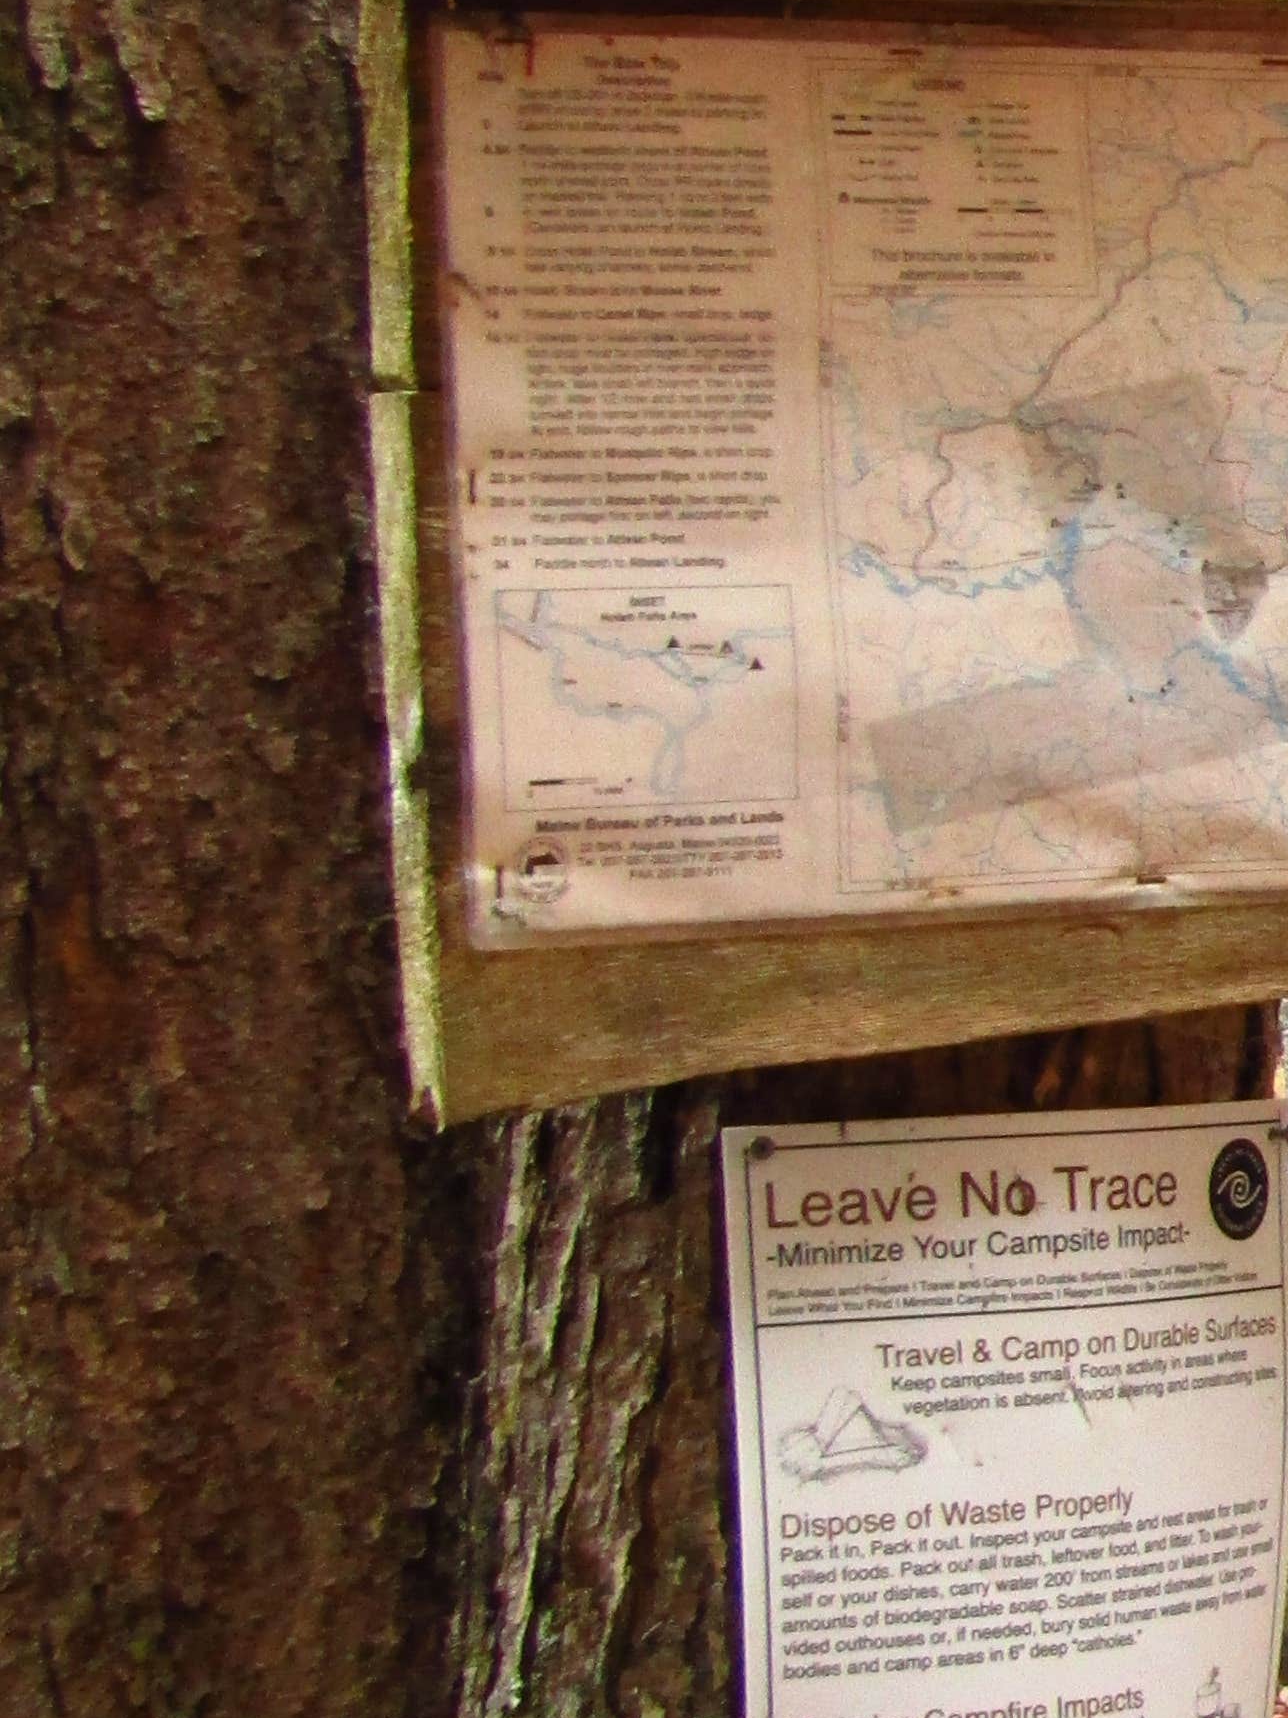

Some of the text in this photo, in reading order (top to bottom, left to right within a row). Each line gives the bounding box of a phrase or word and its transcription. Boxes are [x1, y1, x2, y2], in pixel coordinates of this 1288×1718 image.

[765, 1181, 936, 1228] Leave
[960, 1170, 1035, 1217] No
[1052, 1165, 1177, 1212] Trace
[914, 1235, 977, 1260] Your
[987, 1227, 1109, 1259] Campsite
[874, 1316, 1275, 1368] Travel & Camp on Durable Surfaces
[891, 1376, 935, 1393] Keep
[940, 1370, 1024, 1390] campsites
[1079, 1364, 1121, 1379] Focus
[903, 1395, 989, 1416] vegetation
[995, 1393, 1007, 1408] is
[1167, 1376, 1187, 1393] and
[781, 1485, 1133, 1541] Dispose of Waste Properly
[780, 1544, 823, 1562] Pack
[870, 1538, 912, 1555] Pack
[969, 1530, 1028, 1550] Inspect
[1033, 1528, 1065, 1546] your
[1136, 1514, 1159, 1531] and
[781, 1567, 835, 1589] spilled
[900, 1559, 941, 1577] Pack
[947, 1558, 972, 1573] out
[978, 1554, 996, 1571] all
[1051, 1546, 1104, 1564] leftover
[1144, 1535, 1167, 1552] and
[782, 1592, 812, 1610] self
[817, 1594, 834, 1607] or
[840, 1591, 877, 1609] your
[949, 1582, 990, 1597] carry
[995, 1576, 1038, 1592] water
[1080, 1568, 1110, 1584] from
[782, 1615, 857, 1633] amounts
[862, 1611, 879, 1627] of
[884, 1601, 1003, 1625] biodegradable
[1056, 1591, 1107, 1609] Scatter
[783, 1638, 829, 1656] vided
[834, 1634, 924, 1652] outhouses
[1041, 1618, 1074, 1634] bury
[1078, 1611, 1109, 1629] solid
[1114, 1606, 1156, 1624] human
[783, 1661, 840, 1679] bodies
[846, 1657, 879, 1674] and
[884, 1656, 931, 1672] camp
[937, 1651, 984, 1667] areas
[990, 1647, 1003, 1662] in
[1030, 1642, 1068, 1658] deep
